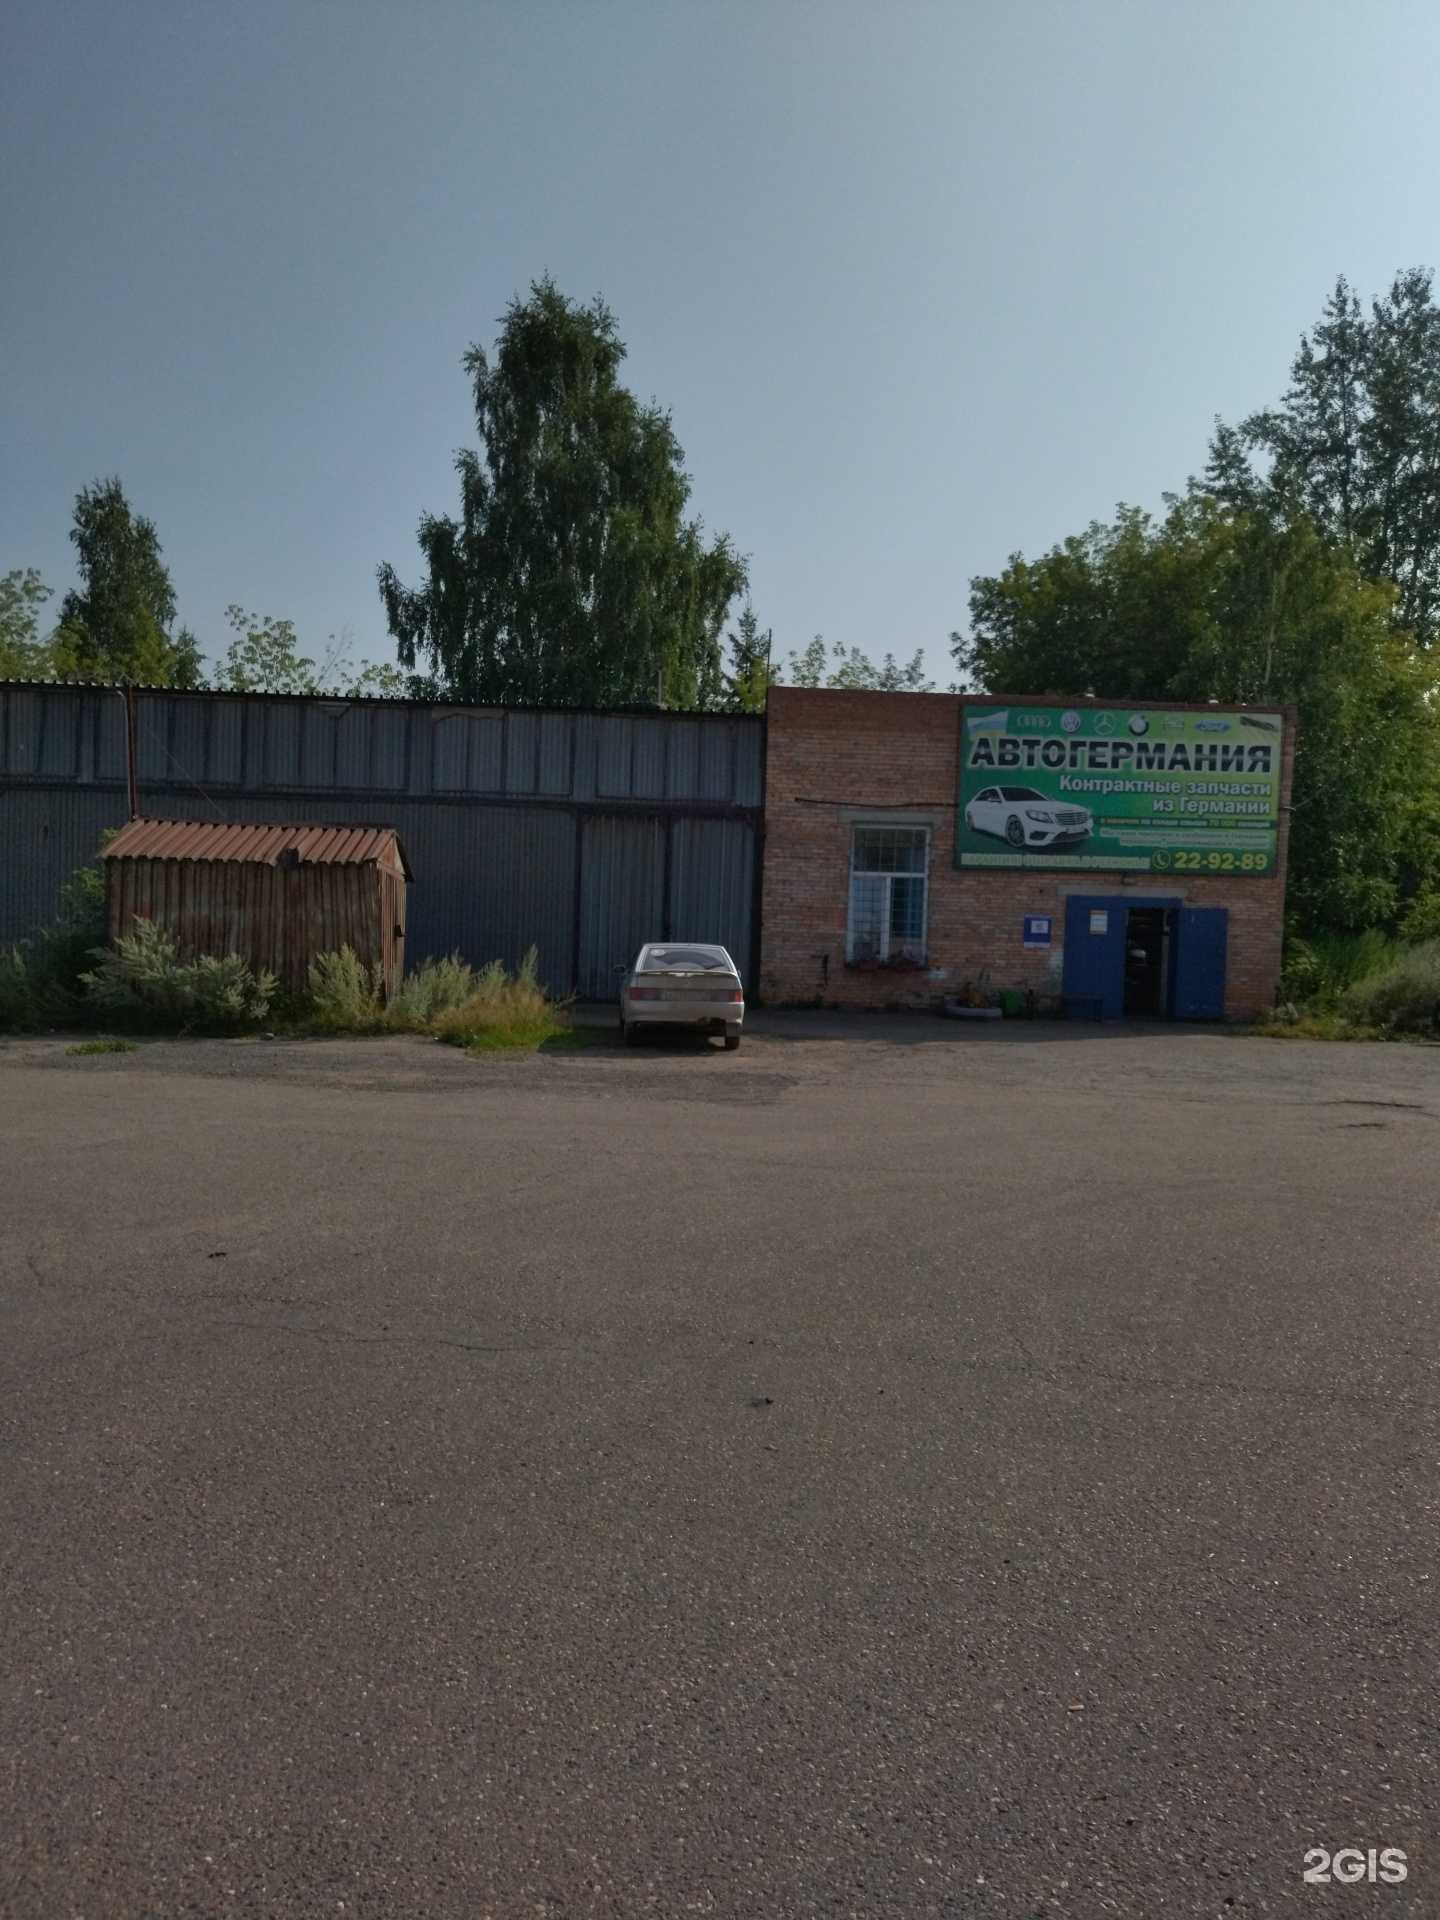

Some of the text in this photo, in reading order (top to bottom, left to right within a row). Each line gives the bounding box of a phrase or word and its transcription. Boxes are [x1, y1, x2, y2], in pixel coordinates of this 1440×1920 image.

[969, 737, 1272, 773] АВТОГЕРМАНИЯ
[1059, 775, 1271, 796] Контрактные запчасти
[1152, 797, 1270, 815] из Германии
[1173, 852, 1268, 871] 22-92-89
